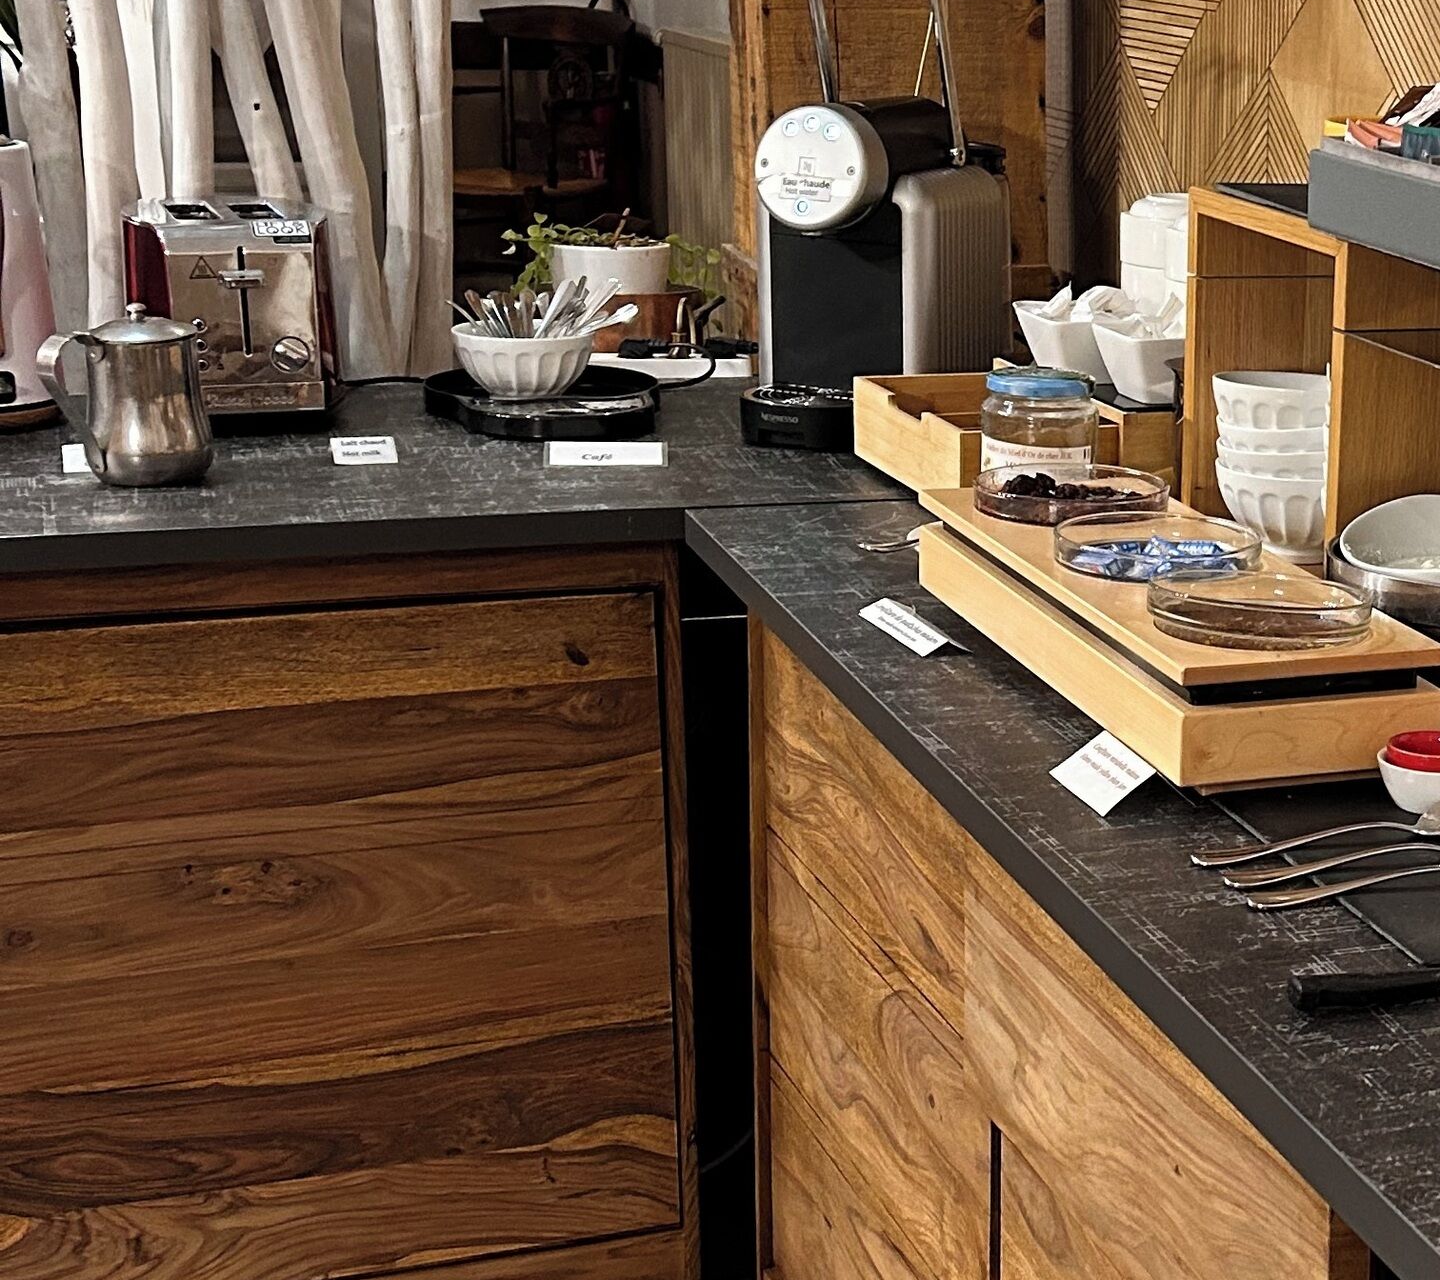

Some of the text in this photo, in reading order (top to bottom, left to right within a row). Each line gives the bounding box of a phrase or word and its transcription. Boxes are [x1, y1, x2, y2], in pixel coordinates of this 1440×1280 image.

[782, 177, 798, 186] Eau
[257, 225, 307, 235] LOOK
[581, 453, 613, 462] Café
